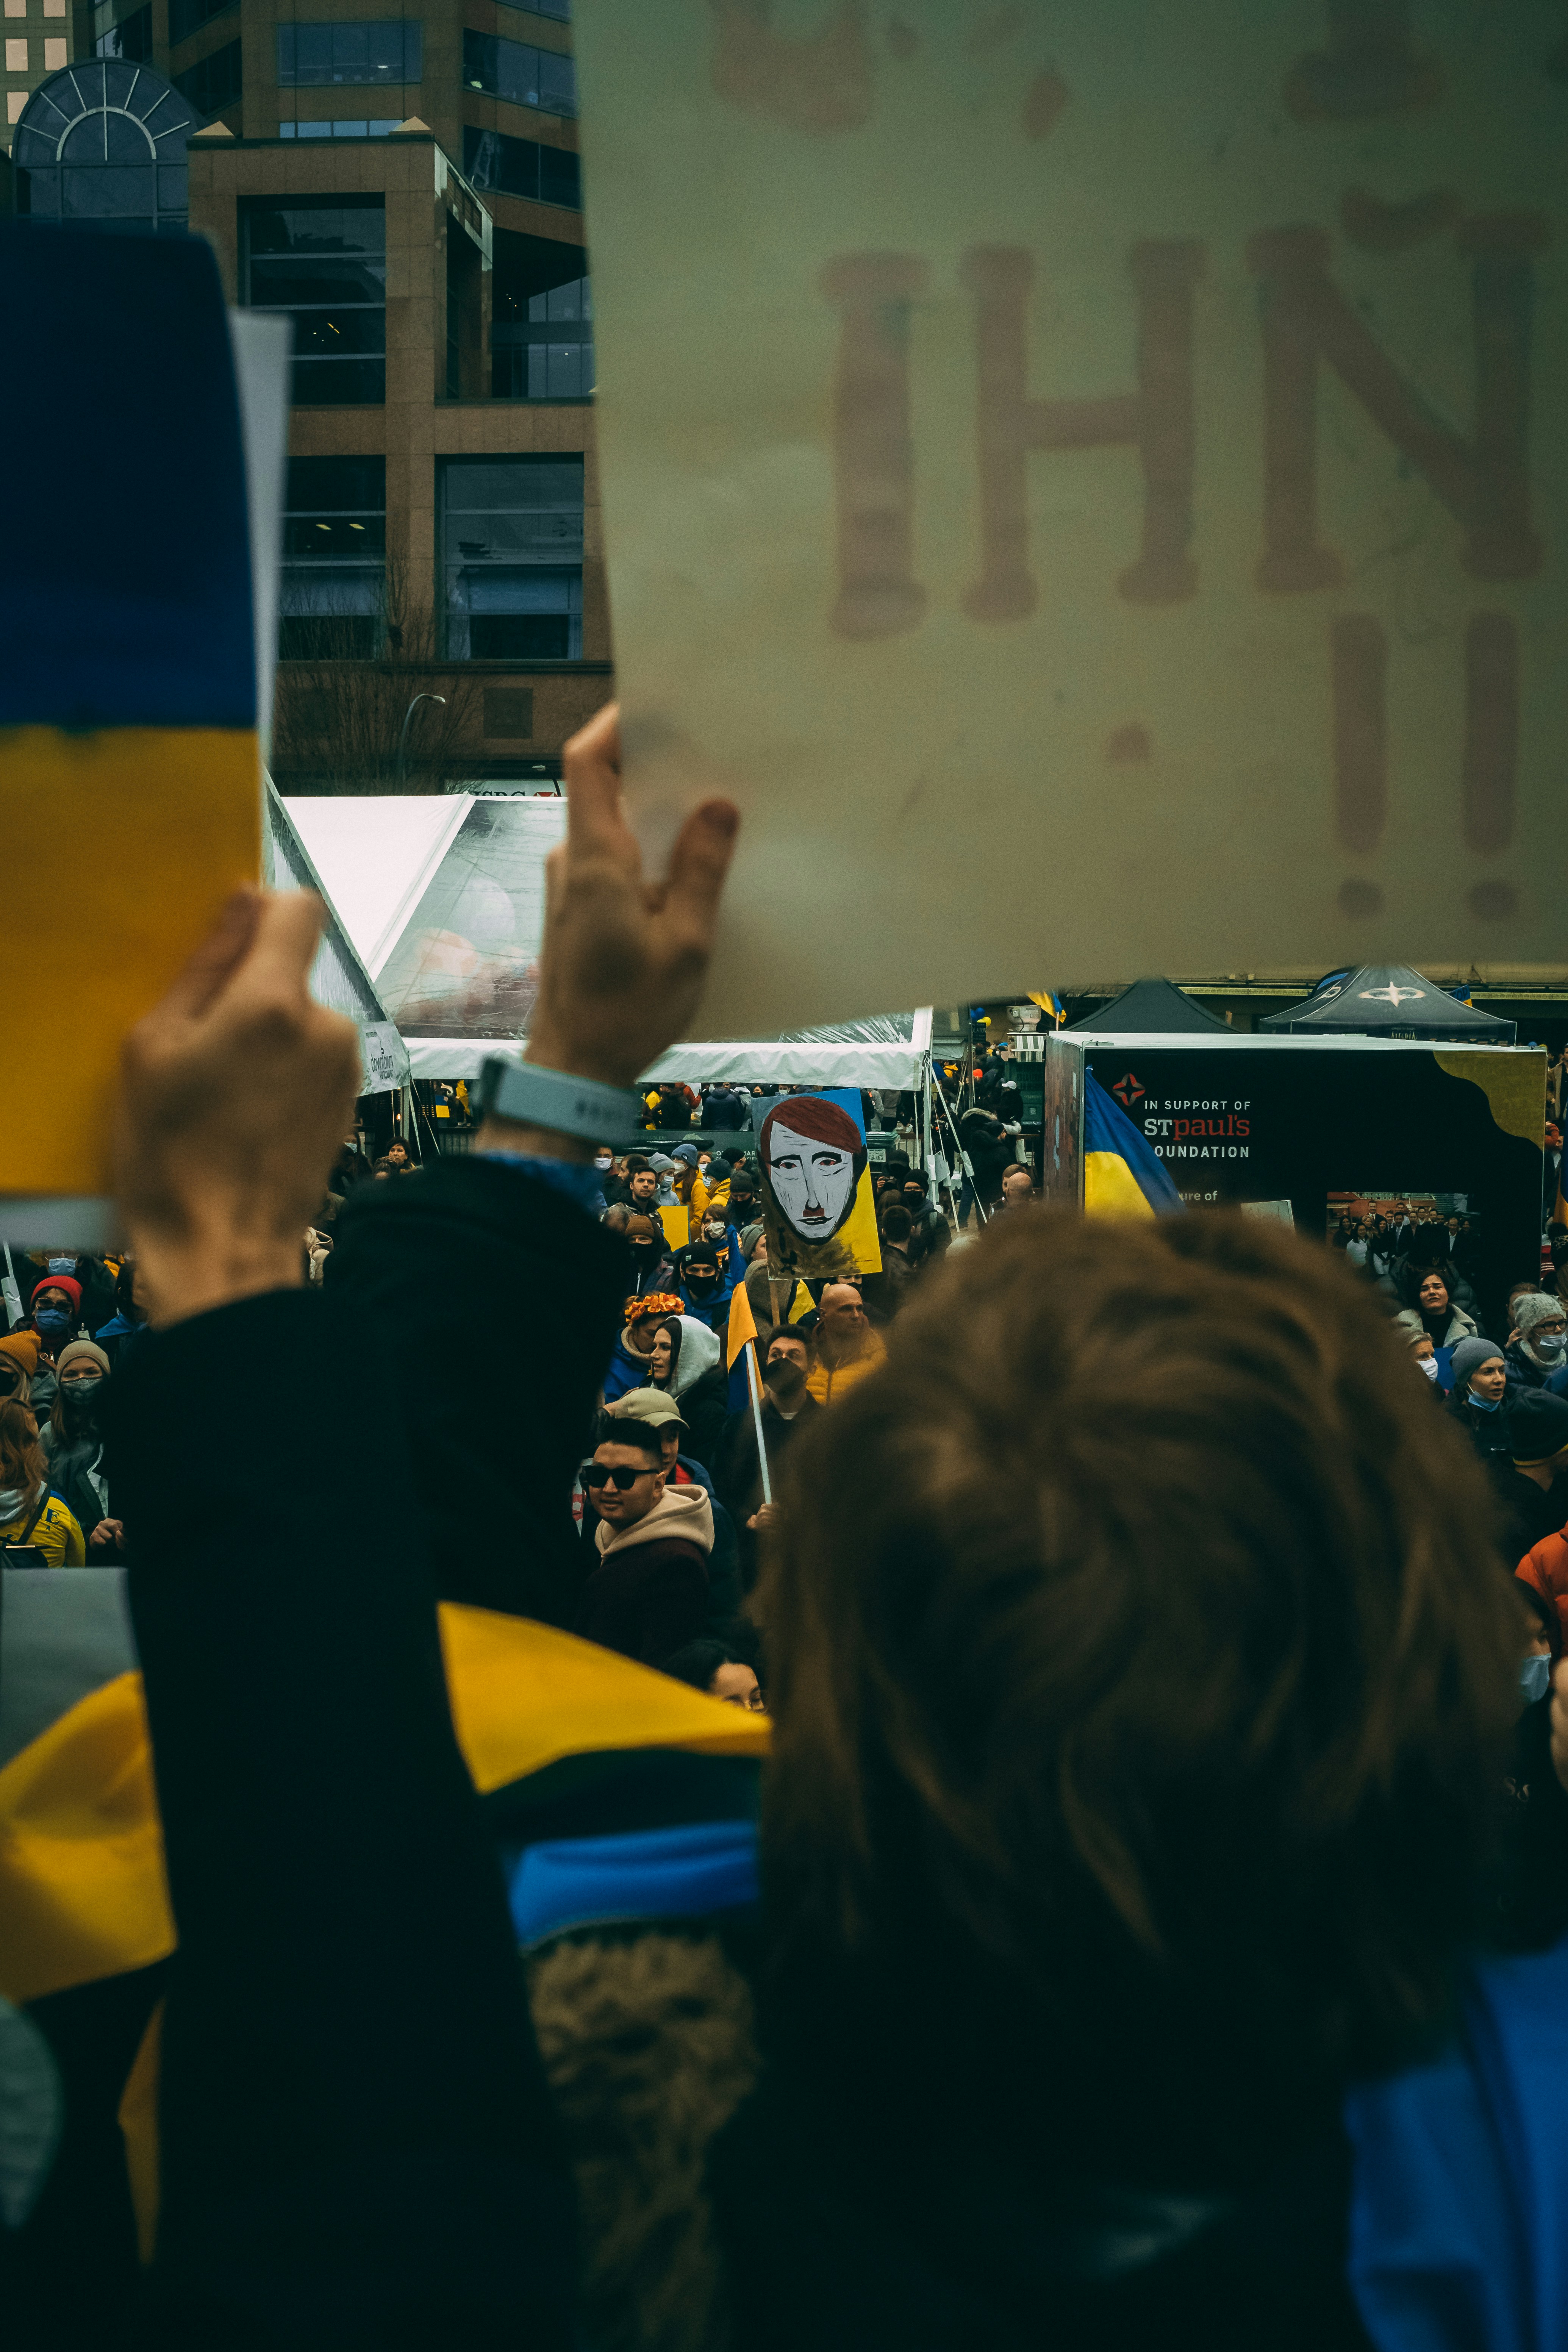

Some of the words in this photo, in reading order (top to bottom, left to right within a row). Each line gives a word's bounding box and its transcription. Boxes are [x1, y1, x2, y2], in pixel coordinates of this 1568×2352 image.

[1144, 1100, 1158, 1109] IN
[1165, 1101, 1227, 1110] SUPPORT
[1234, 1101, 1251, 1110] OF
[1154, 1146, 1249, 1158] OUNDATION
[1204, 1190, 1218, 1200] of
